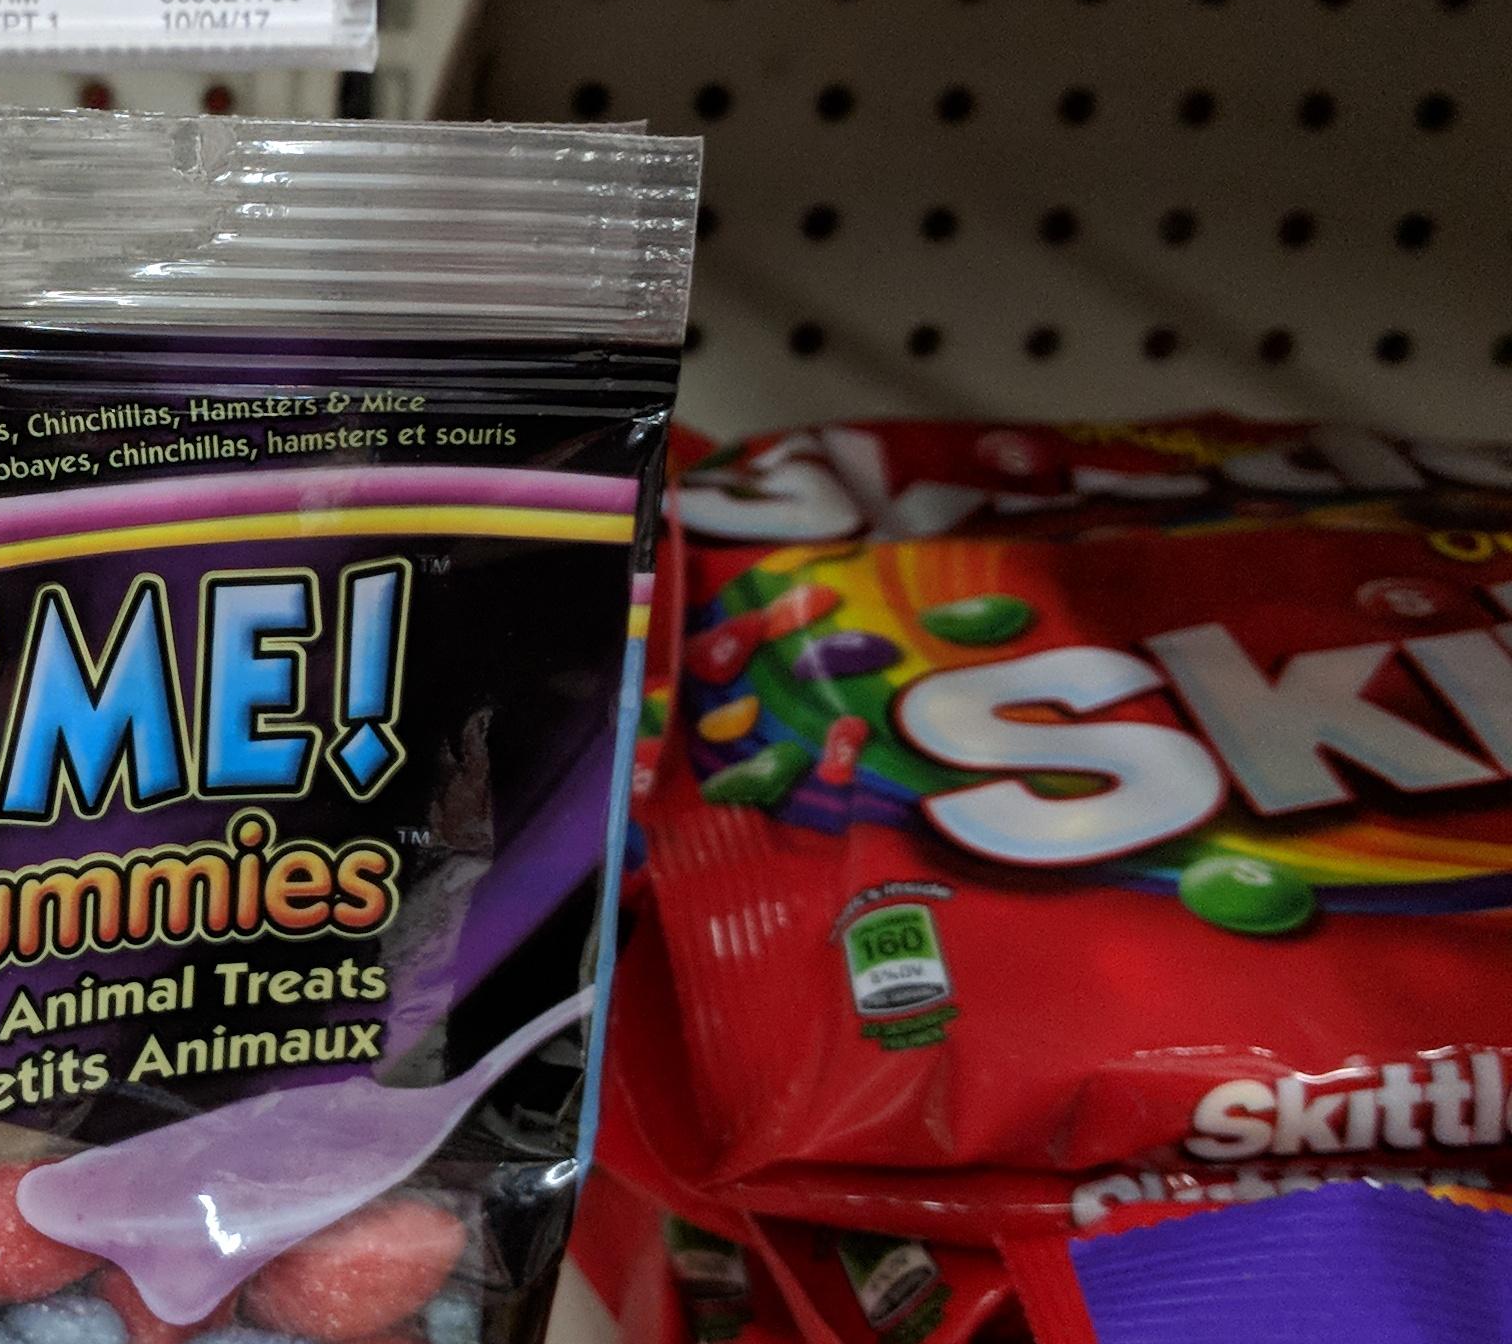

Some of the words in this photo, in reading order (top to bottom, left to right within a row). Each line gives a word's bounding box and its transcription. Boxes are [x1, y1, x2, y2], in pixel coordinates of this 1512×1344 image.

[26, 403, 181, 439] Chinchillas,
[189, 392, 318, 423] Hamsters
[326, 390, 351, 415] &
[360, 389, 427, 414] Mice
[108, 432, 259, 468] chinchillas,
[266, 427, 388, 455] hamsters
[398, 423, 427, 446] et
[435, 422, 517, 447] souris
[214, 960, 388, 1006] Treats
[128, 1021, 382, 1083] Animaux
[1188, 1053, 1512, 1162] Skittl
